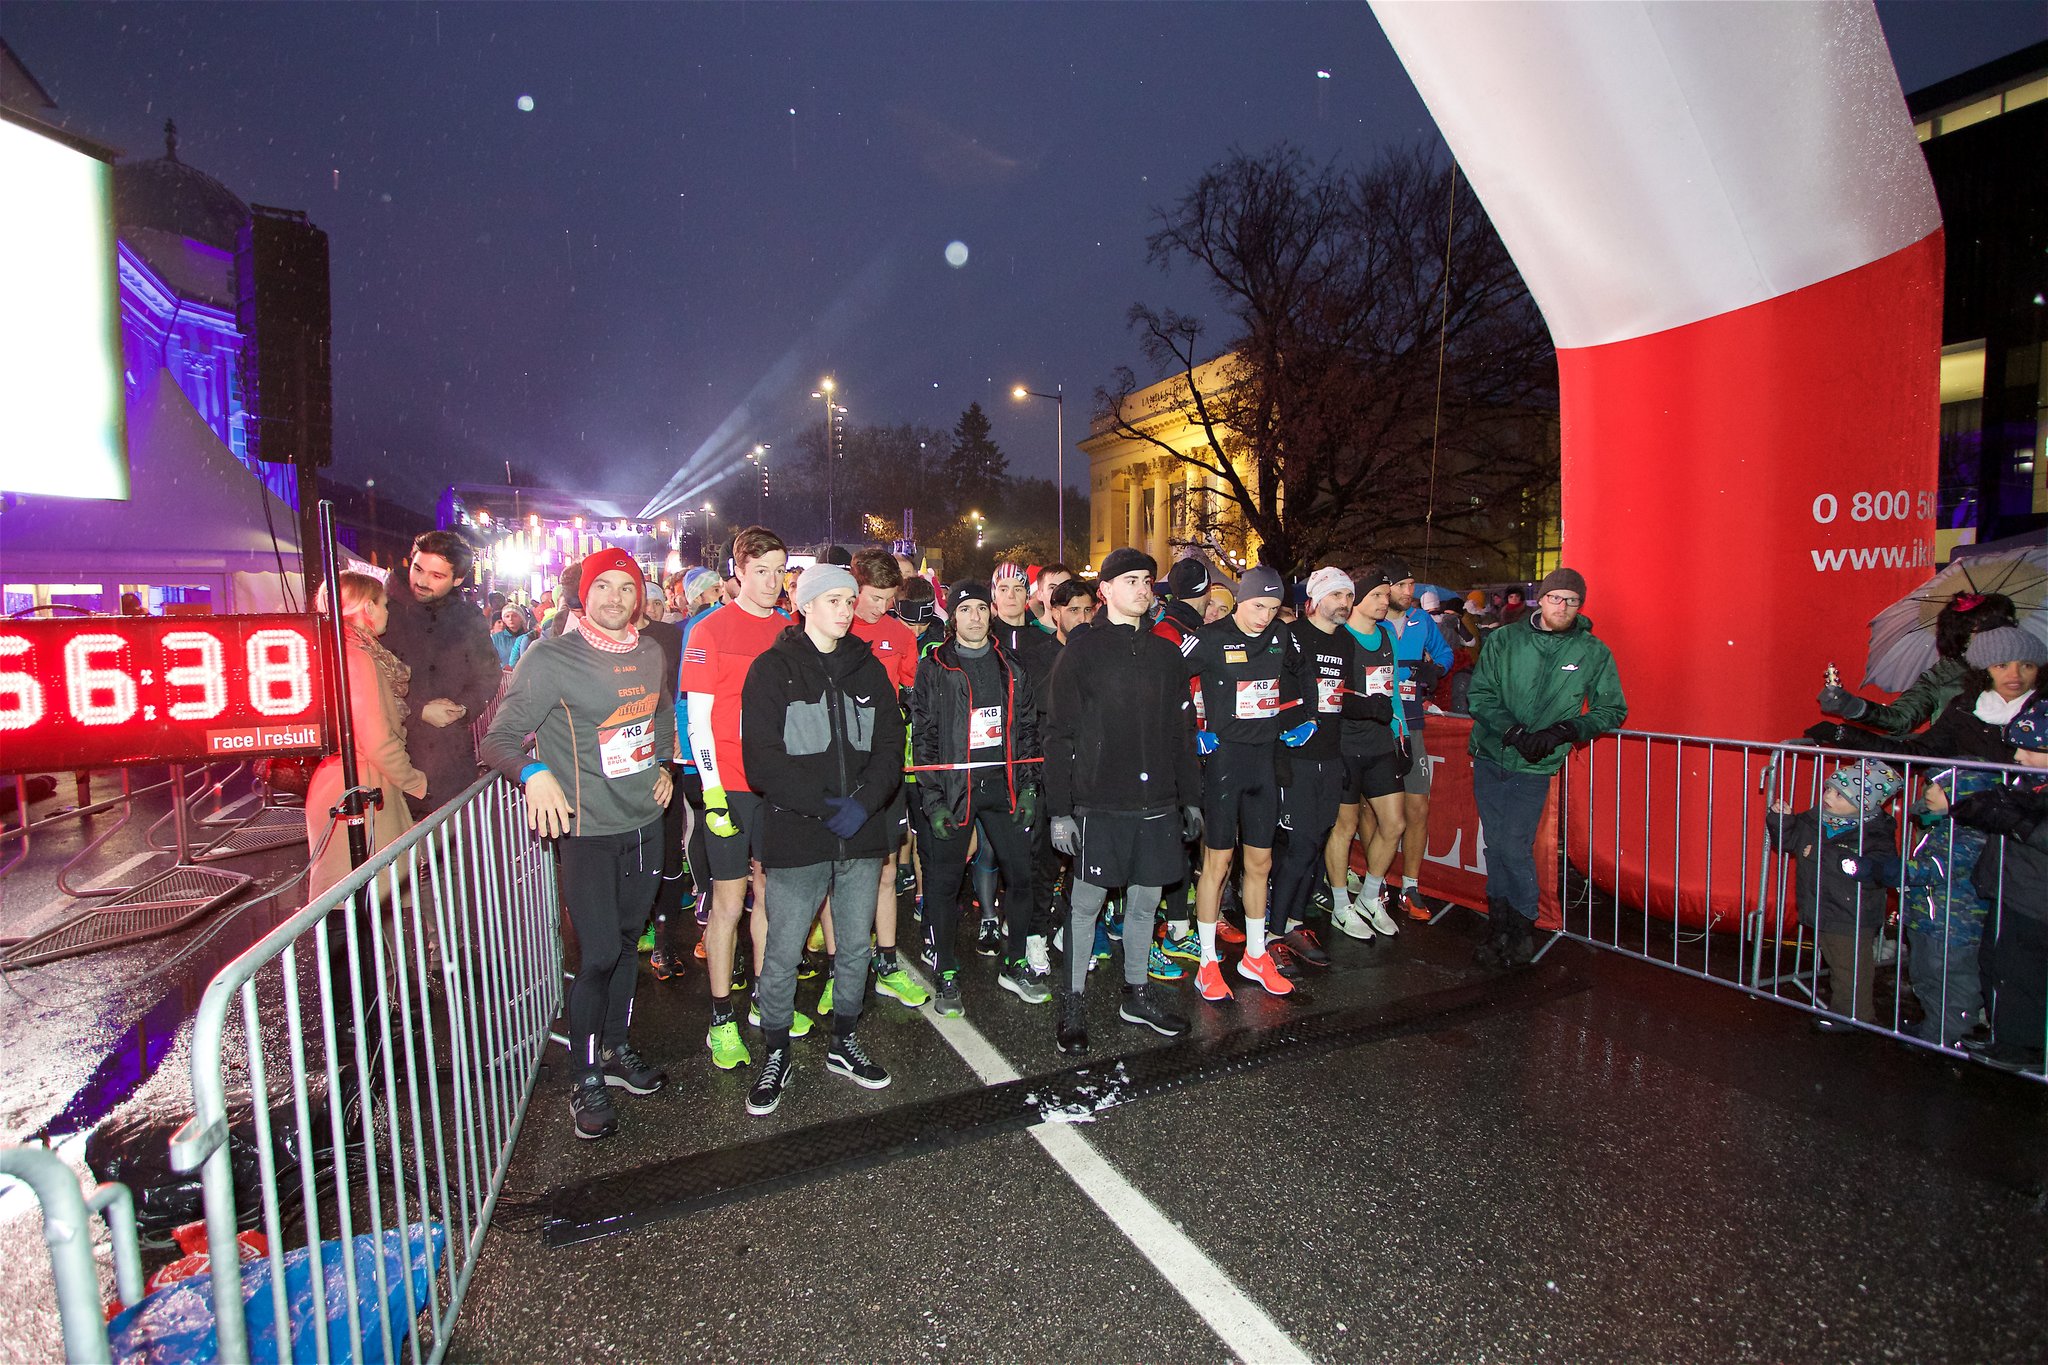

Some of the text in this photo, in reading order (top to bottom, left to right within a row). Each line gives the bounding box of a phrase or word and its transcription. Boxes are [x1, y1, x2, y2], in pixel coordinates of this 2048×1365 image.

[1812, 493, 1838, 524] 0
[1850, 490, 1910, 522] 800
[1319, 666, 1341, 677] 1966
[618, 687, 641, 697] ERSTE
[214, 726, 316, 750] race result
